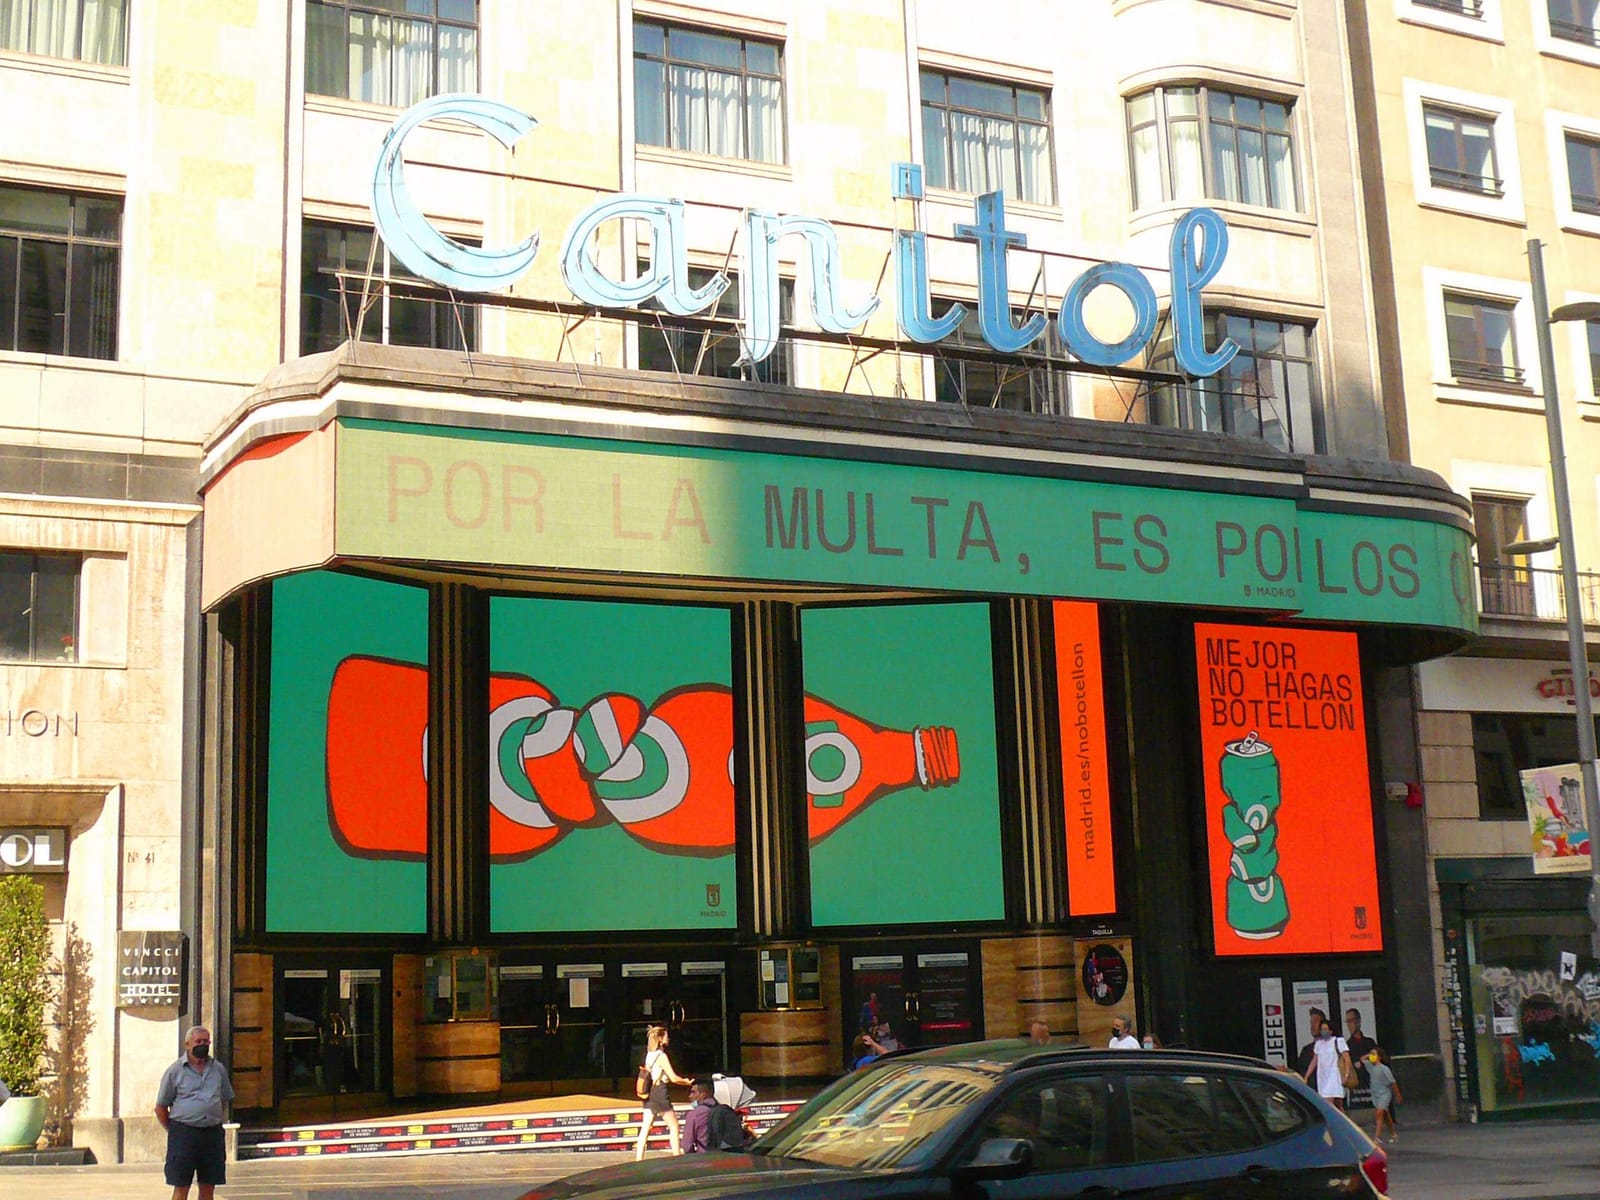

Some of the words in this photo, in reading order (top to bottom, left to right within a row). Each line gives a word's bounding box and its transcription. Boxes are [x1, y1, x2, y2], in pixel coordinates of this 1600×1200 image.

[372, 92, 1241, 378] Capitol
[387, 455, 546, 534] POR
[612, 473, 711, 545] LA
[764, 485, 1030, 575] MULTA,
[1092, 511, 1170, 574] ES
[1256, 586, 1296, 598] MADRID
[1206, 638, 1296, 670] MEJOR
[1209, 669, 1244, 697] NO
[1265, 671, 1353, 702] HAGAS
[1072, 642, 1096, 859] madrid.es/nobotellon
[0, 834, 64, 867] OL
[123, 947, 179, 956] VINCCI
[122, 966, 178, 976] CAPITOL
[127, 985, 172, 995] HOTEL
[1265, 1018, 1285, 1059] JEFE
